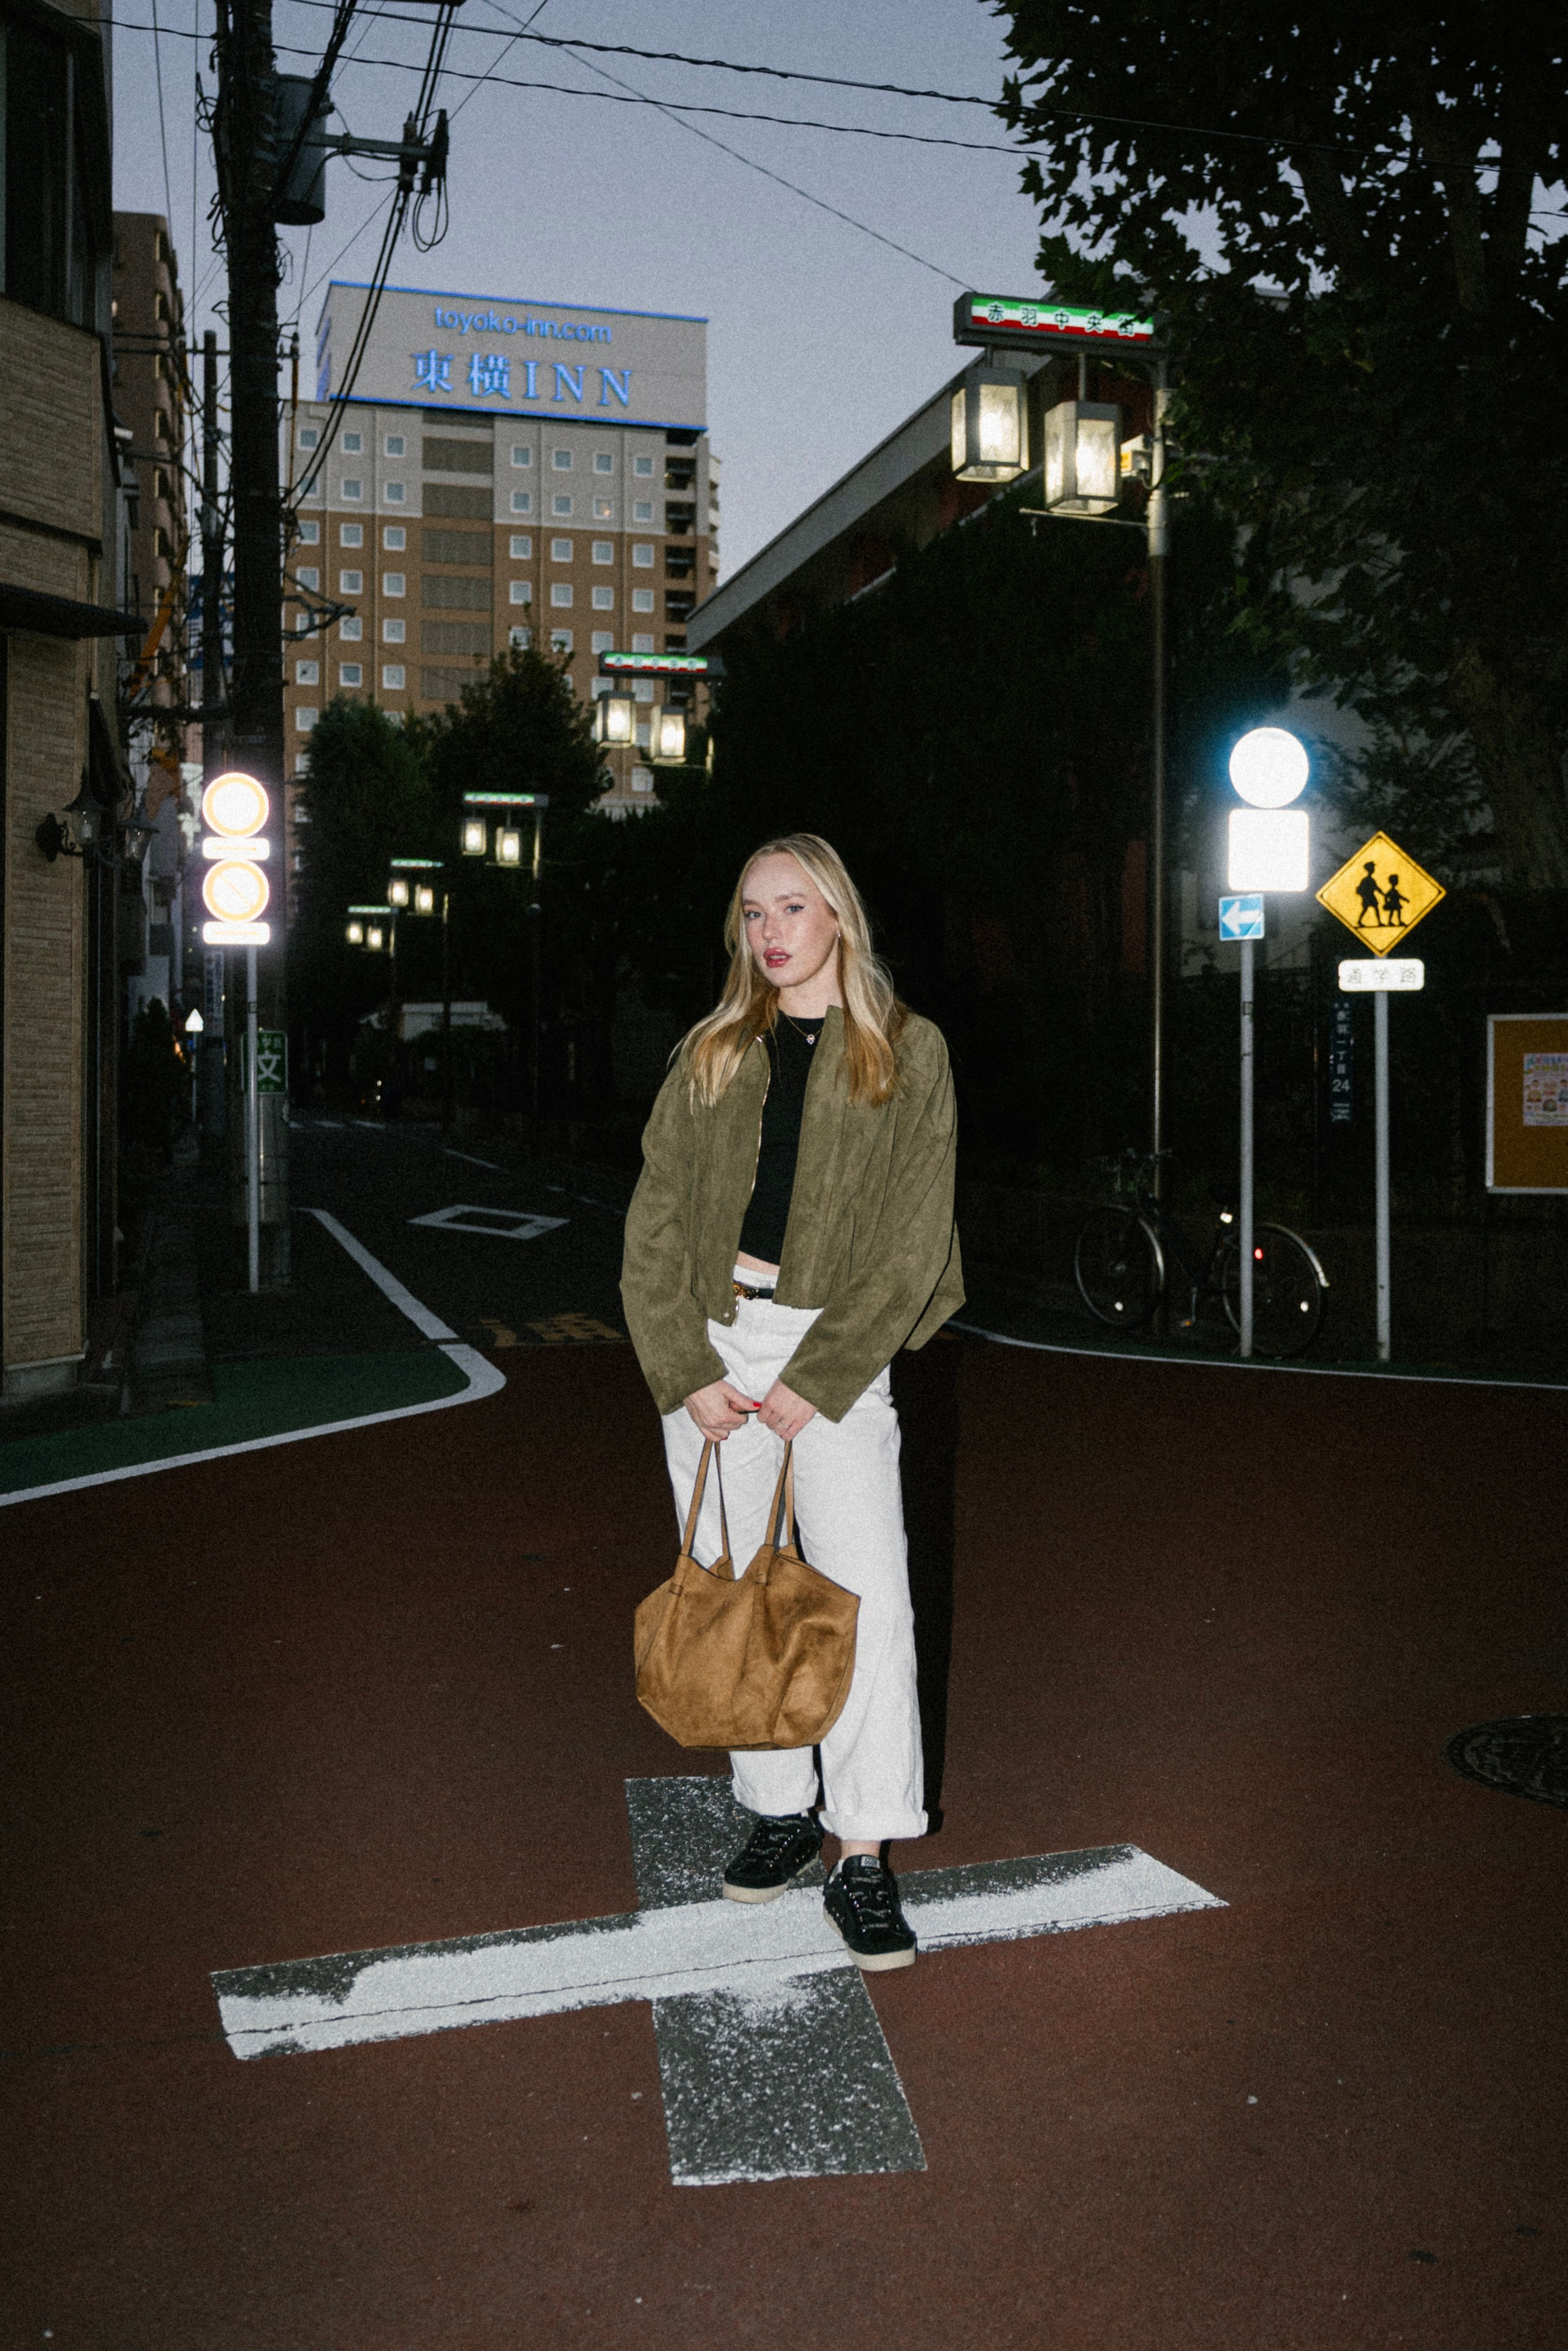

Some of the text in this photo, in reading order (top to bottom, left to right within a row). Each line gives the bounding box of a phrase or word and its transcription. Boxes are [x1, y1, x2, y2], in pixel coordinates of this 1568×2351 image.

[434, 306, 612, 343] toyoko-inn.com
[411, 349, 632, 406] 東横INN
[1332, 1079, 1351, 1092] 24
